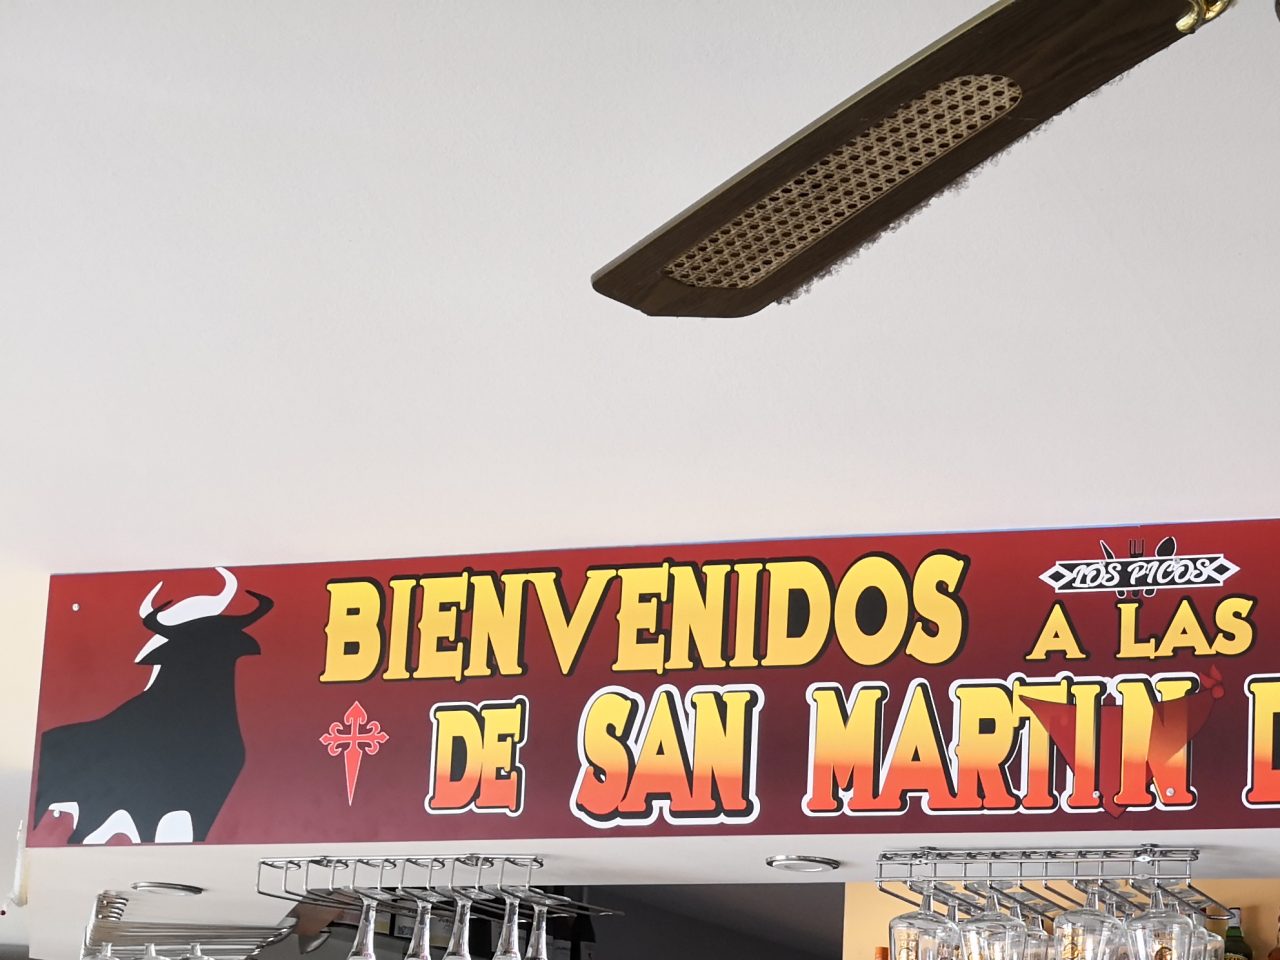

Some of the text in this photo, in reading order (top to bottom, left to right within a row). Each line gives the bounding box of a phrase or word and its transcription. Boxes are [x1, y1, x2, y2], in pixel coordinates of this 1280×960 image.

[319, 549, 971, 683] BIENVENIDOS
[1072, 558, 1211, 587] LOS PICOS
[1025, 594, 1257, 663] A LAS
[423, 694, 531, 819] DE
[569, 682, 767, 828] SAN
[802, 672, 1202, 819] MARTIN
